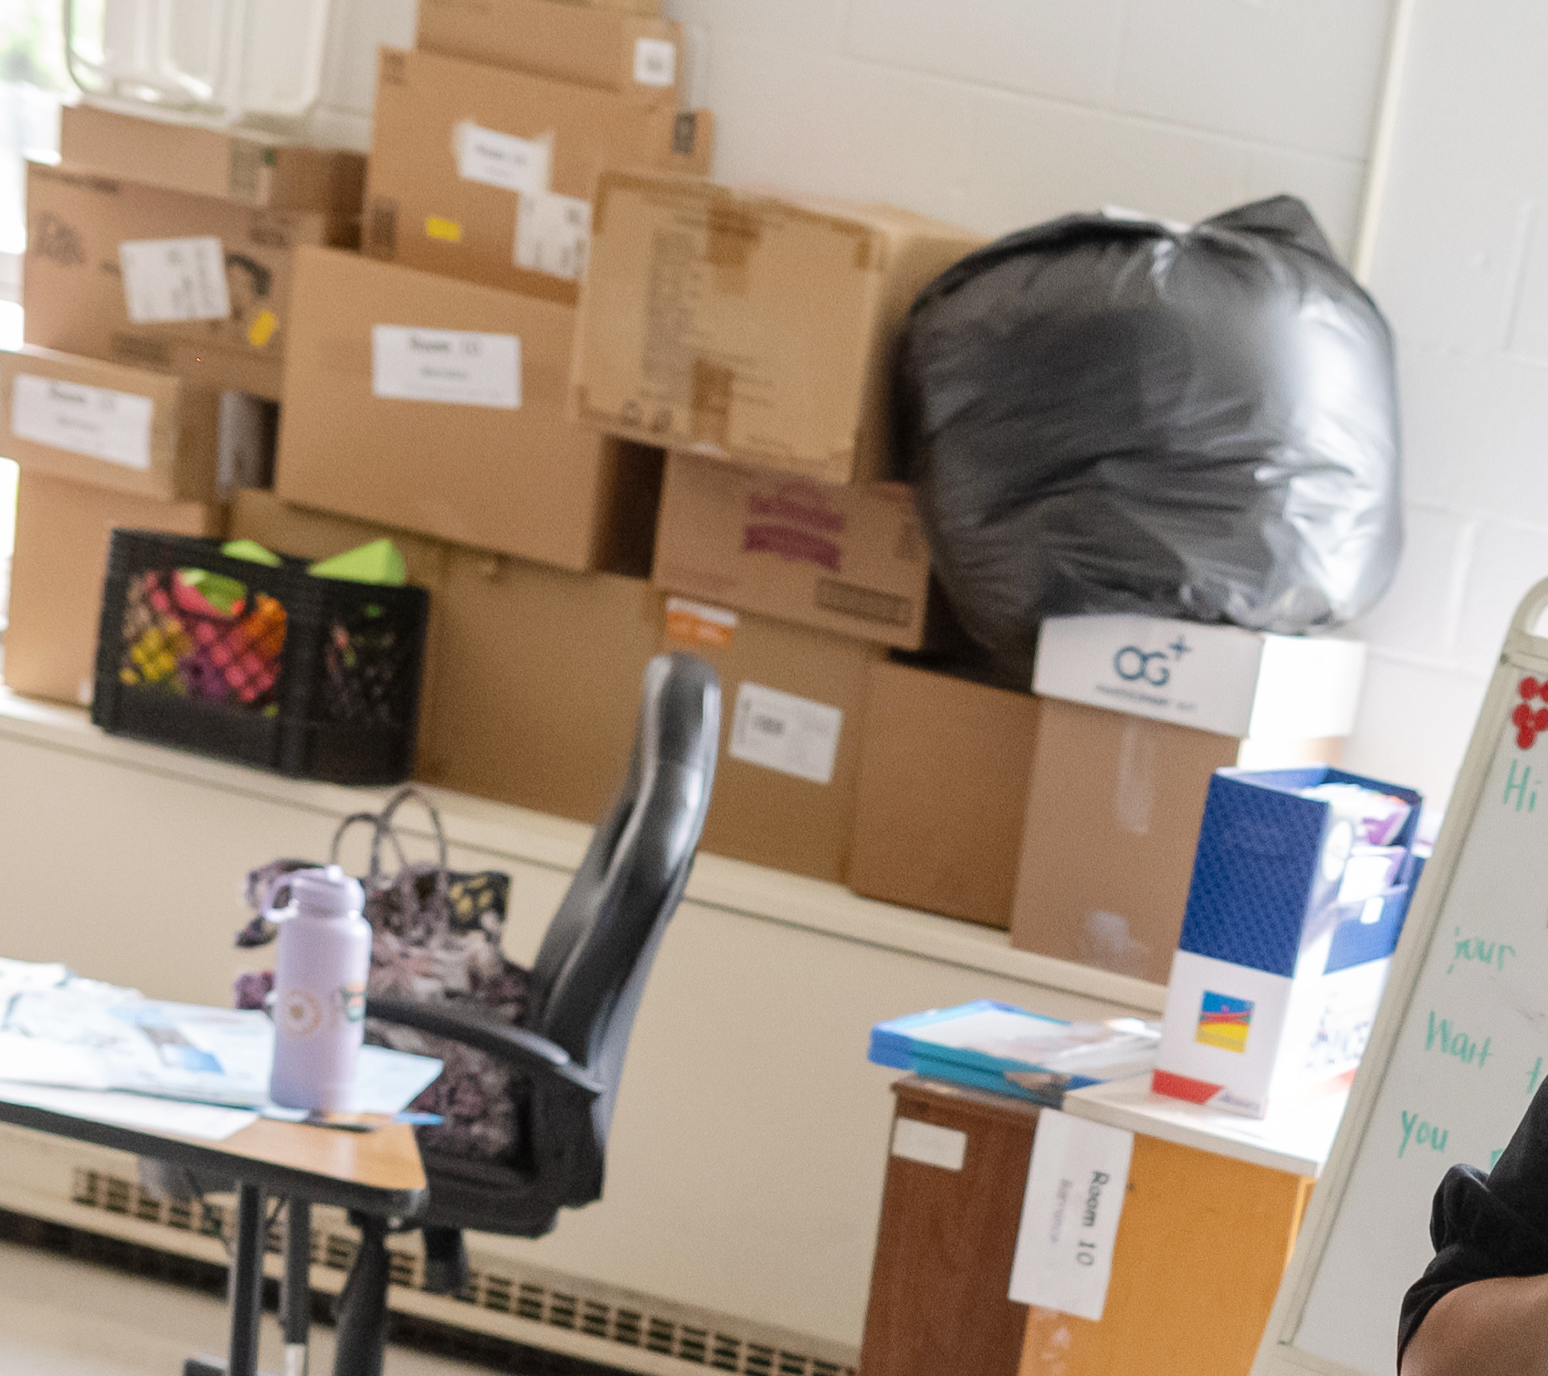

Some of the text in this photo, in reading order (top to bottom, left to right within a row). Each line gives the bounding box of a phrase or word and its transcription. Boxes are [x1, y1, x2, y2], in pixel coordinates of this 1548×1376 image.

[1502, 758, 1544, 814] Hi
[1397, 1109, 1449, 1160] you
[1075, 1170, 1111, 1267] Room 10
